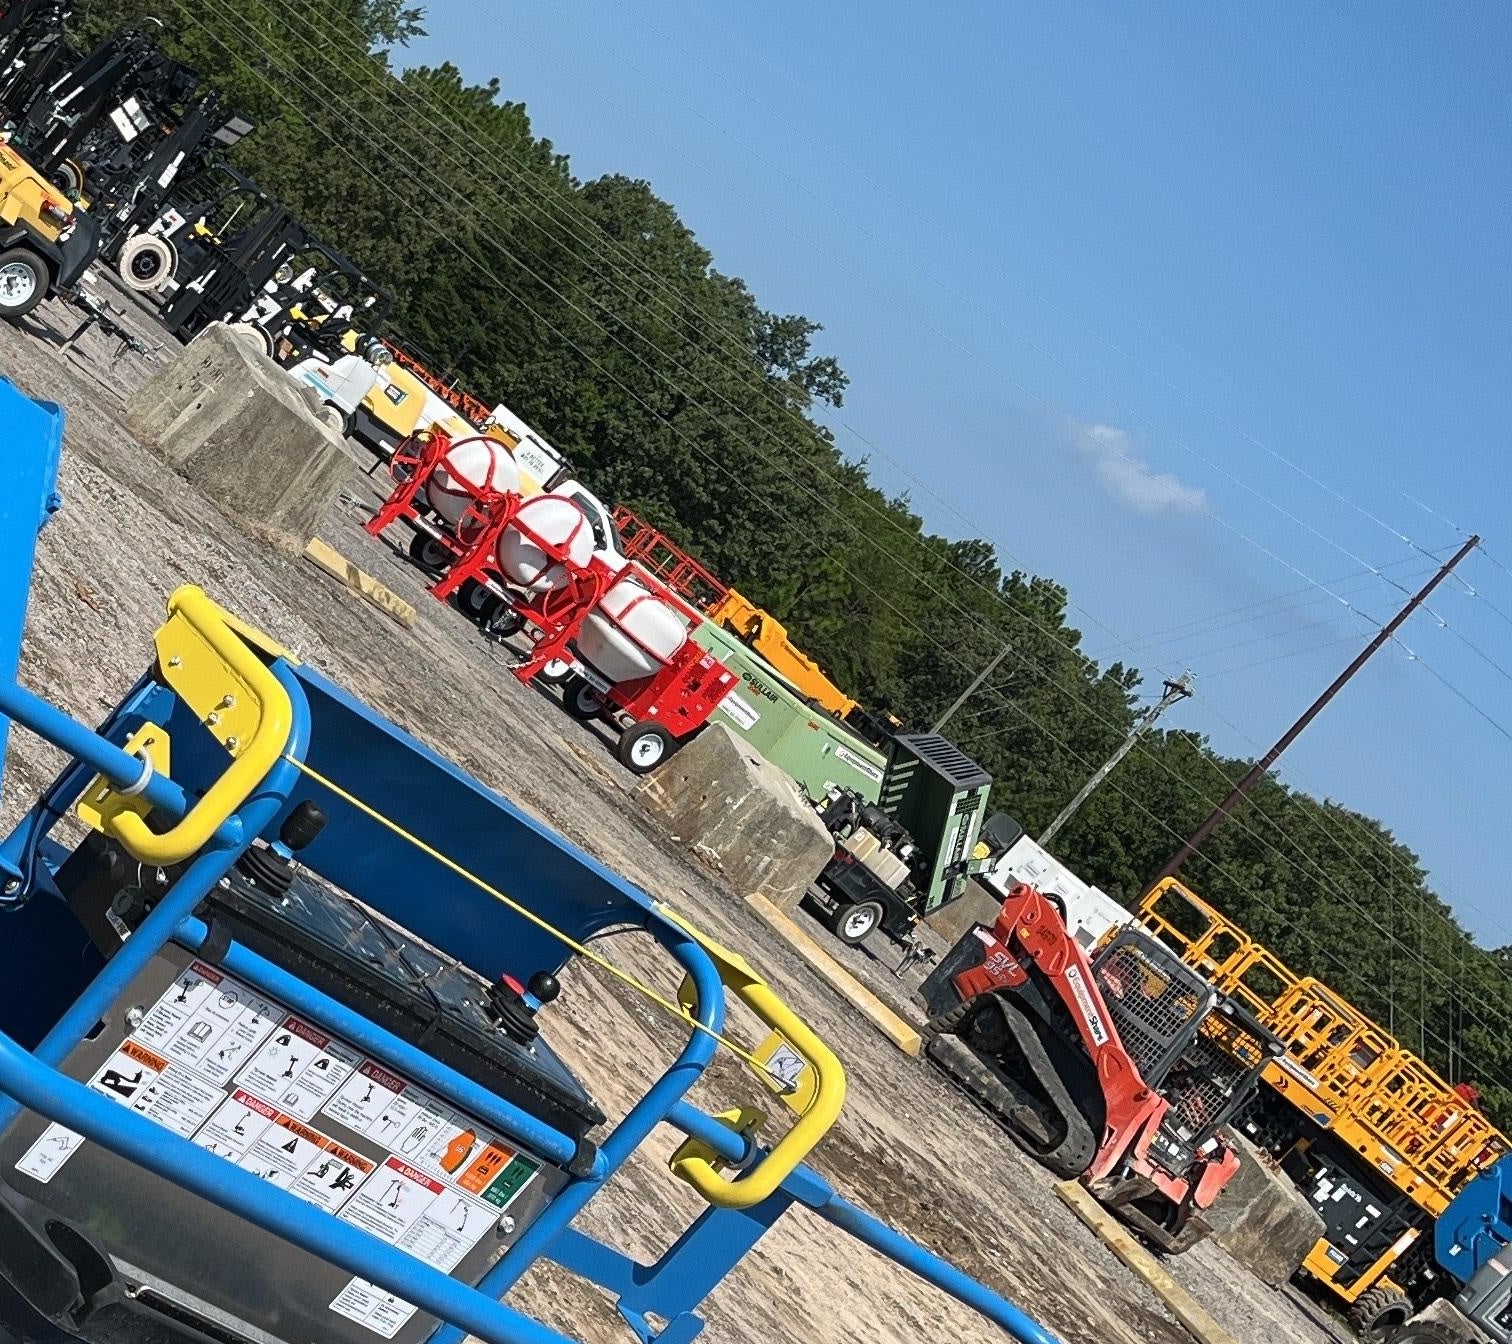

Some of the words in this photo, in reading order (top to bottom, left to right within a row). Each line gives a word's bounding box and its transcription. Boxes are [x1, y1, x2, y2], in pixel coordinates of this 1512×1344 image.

[749, 678, 779, 704] SULLAIR
[296, 1024, 328, 1046] DANGER
[128, 1046, 165, 1071] WARNING
[371, 1070, 403, 1091] DANGER
[244, 1095, 275, 1118] DANGER
[403, 1165, 432, 1187] DANGER
